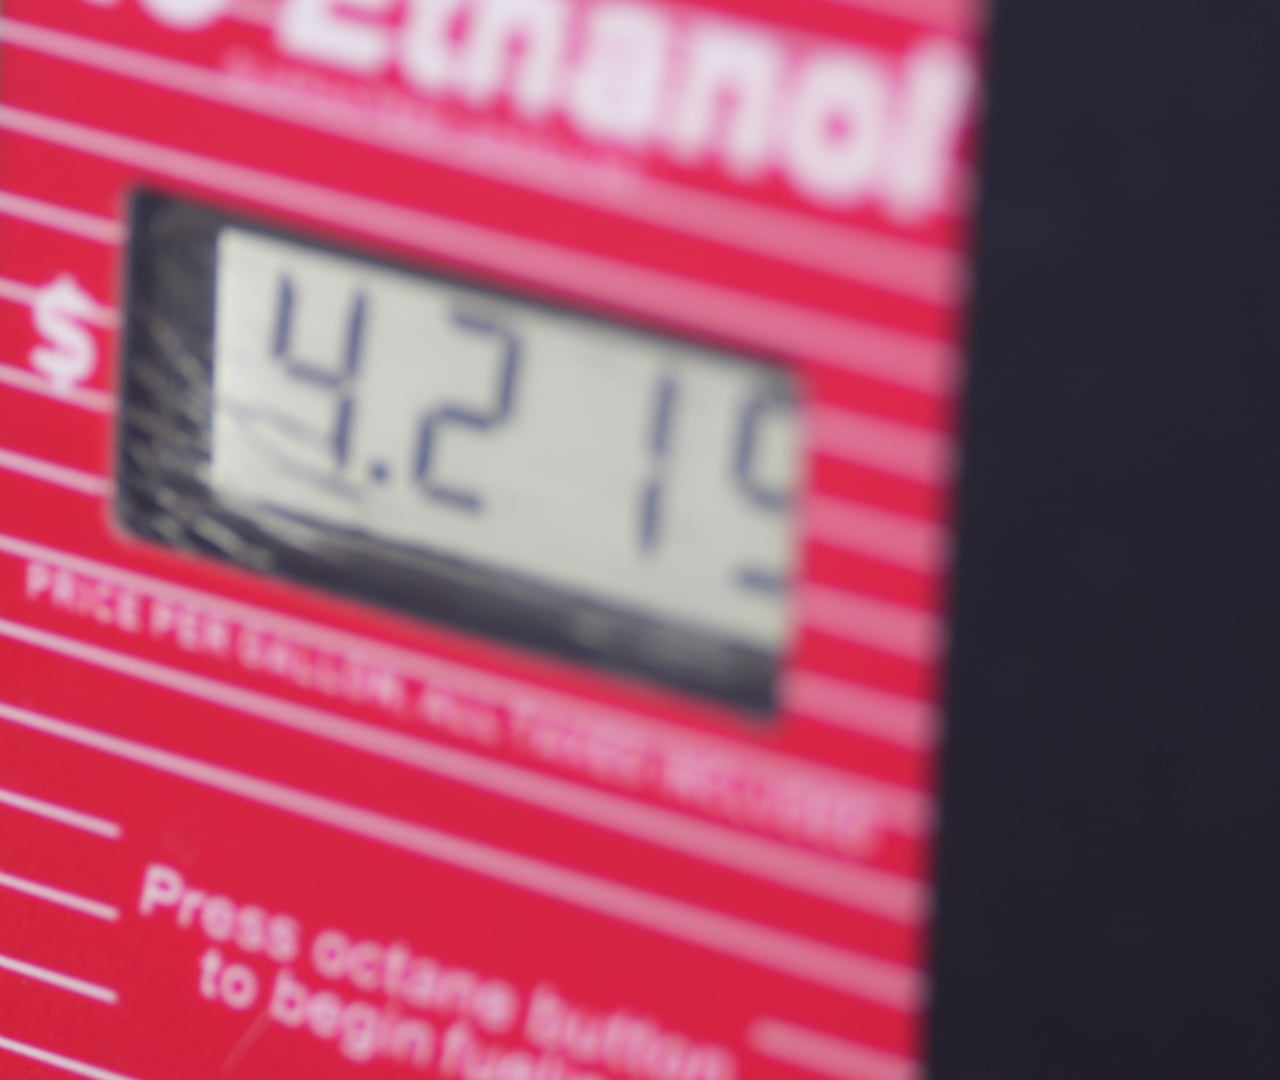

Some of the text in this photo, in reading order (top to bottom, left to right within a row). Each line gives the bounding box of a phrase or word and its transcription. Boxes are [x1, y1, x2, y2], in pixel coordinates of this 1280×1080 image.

[30, 274, 97, 394] $
[25, 564, 140, 634] PRICE
[149, 598, 231, 662] PER
[139, 862, 300, 963] Press
[311, 928, 518, 1034] octane
[199, 944, 259, 1010] to
[269, 963, 435, 1070] begin
